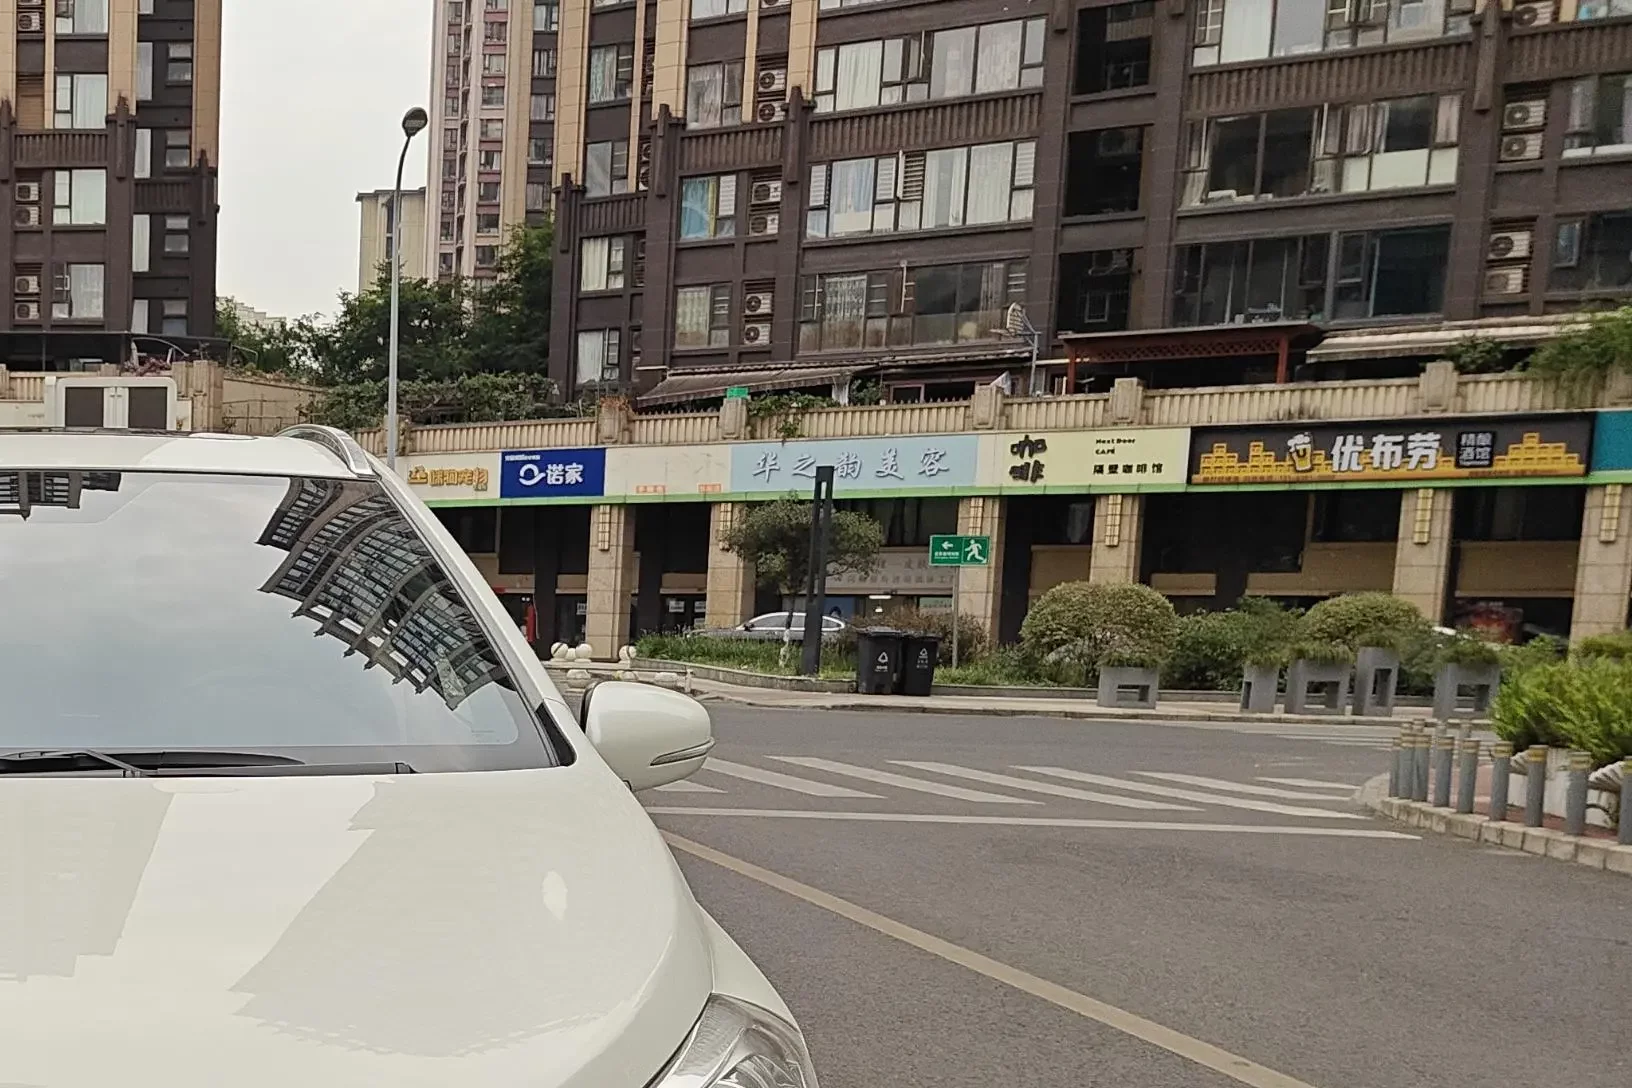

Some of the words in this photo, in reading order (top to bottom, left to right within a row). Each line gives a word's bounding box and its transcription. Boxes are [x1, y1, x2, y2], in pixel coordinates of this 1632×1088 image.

[752, 447, 949, 482] 华之韵美容
[1331, 432, 1441, 472] 优布劳
[545, 463, 584, 485] 诺家
